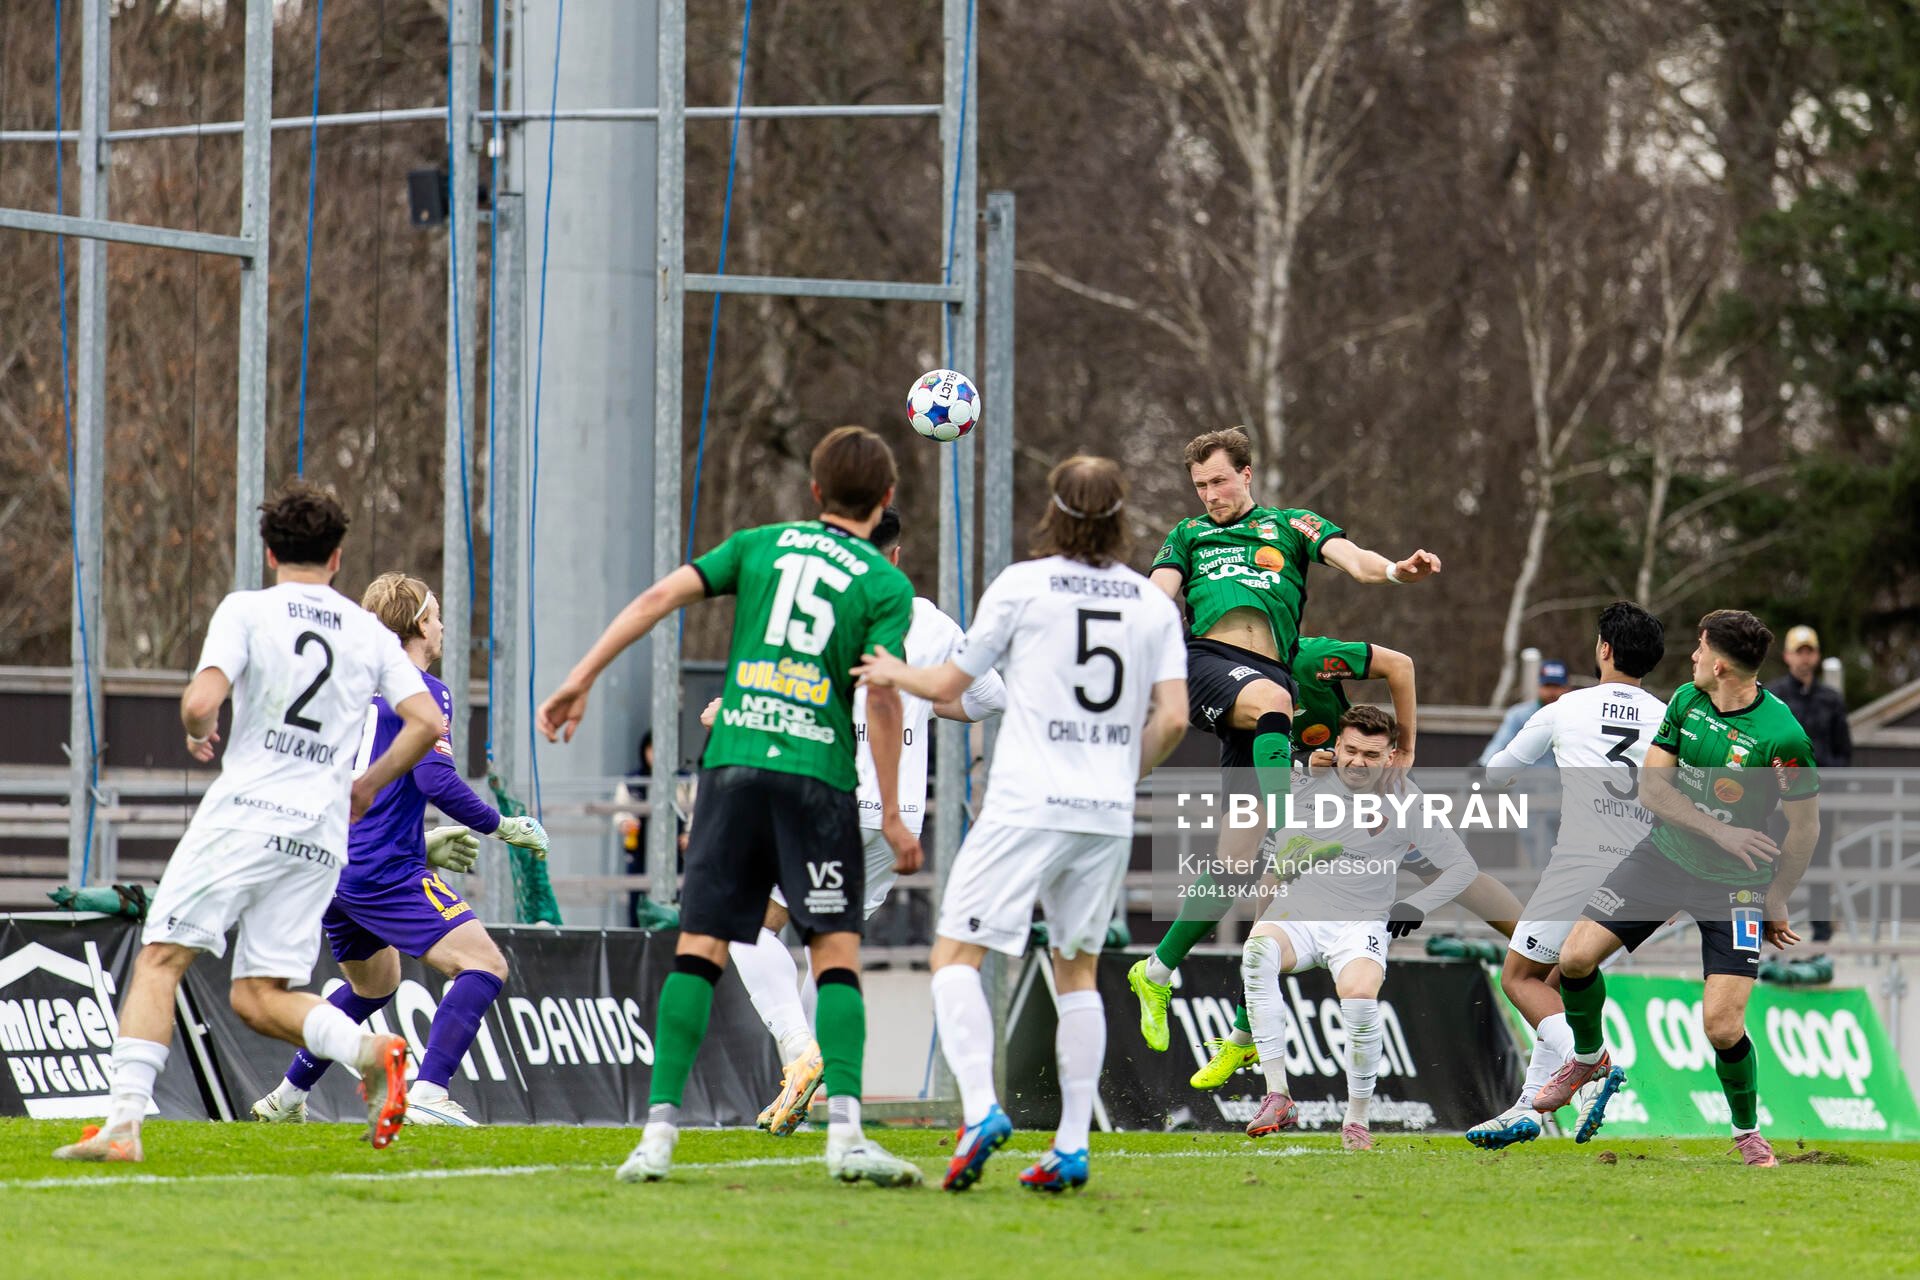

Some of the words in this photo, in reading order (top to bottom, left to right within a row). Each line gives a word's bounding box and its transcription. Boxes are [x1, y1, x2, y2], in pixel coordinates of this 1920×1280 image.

[776, 528, 869, 576] Derome
[1198, 546, 1246, 560] Varbergs
[1198, 553, 1246, 574] Sparbank
[1050, 574, 1141, 600] ANDERSSON
[764, 552, 853, 656] 15
[1074, 608, 1124, 713] 5
[1323, 658, 1348, 671] ICA
[284, 630, 334, 733] 2
[737, 660, 831, 706] Ullared
[741, 694, 816, 725] NORDIC
[1602, 702, 1641, 721] FAZAL
[722, 708, 835, 744] WELLNESS
[1106, 724, 1131, 745] WO
[293, 738, 306, 757] &
[1601, 725, 1640, 801] 3
[1598, 844, 1632, 857] BAKED
[806, 860, 843, 889] VS
[1368, 935, 1380, 950] 12
[508, 996, 655, 1066] DAVIDS
[1766, 1006, 1873, 1096] coop
